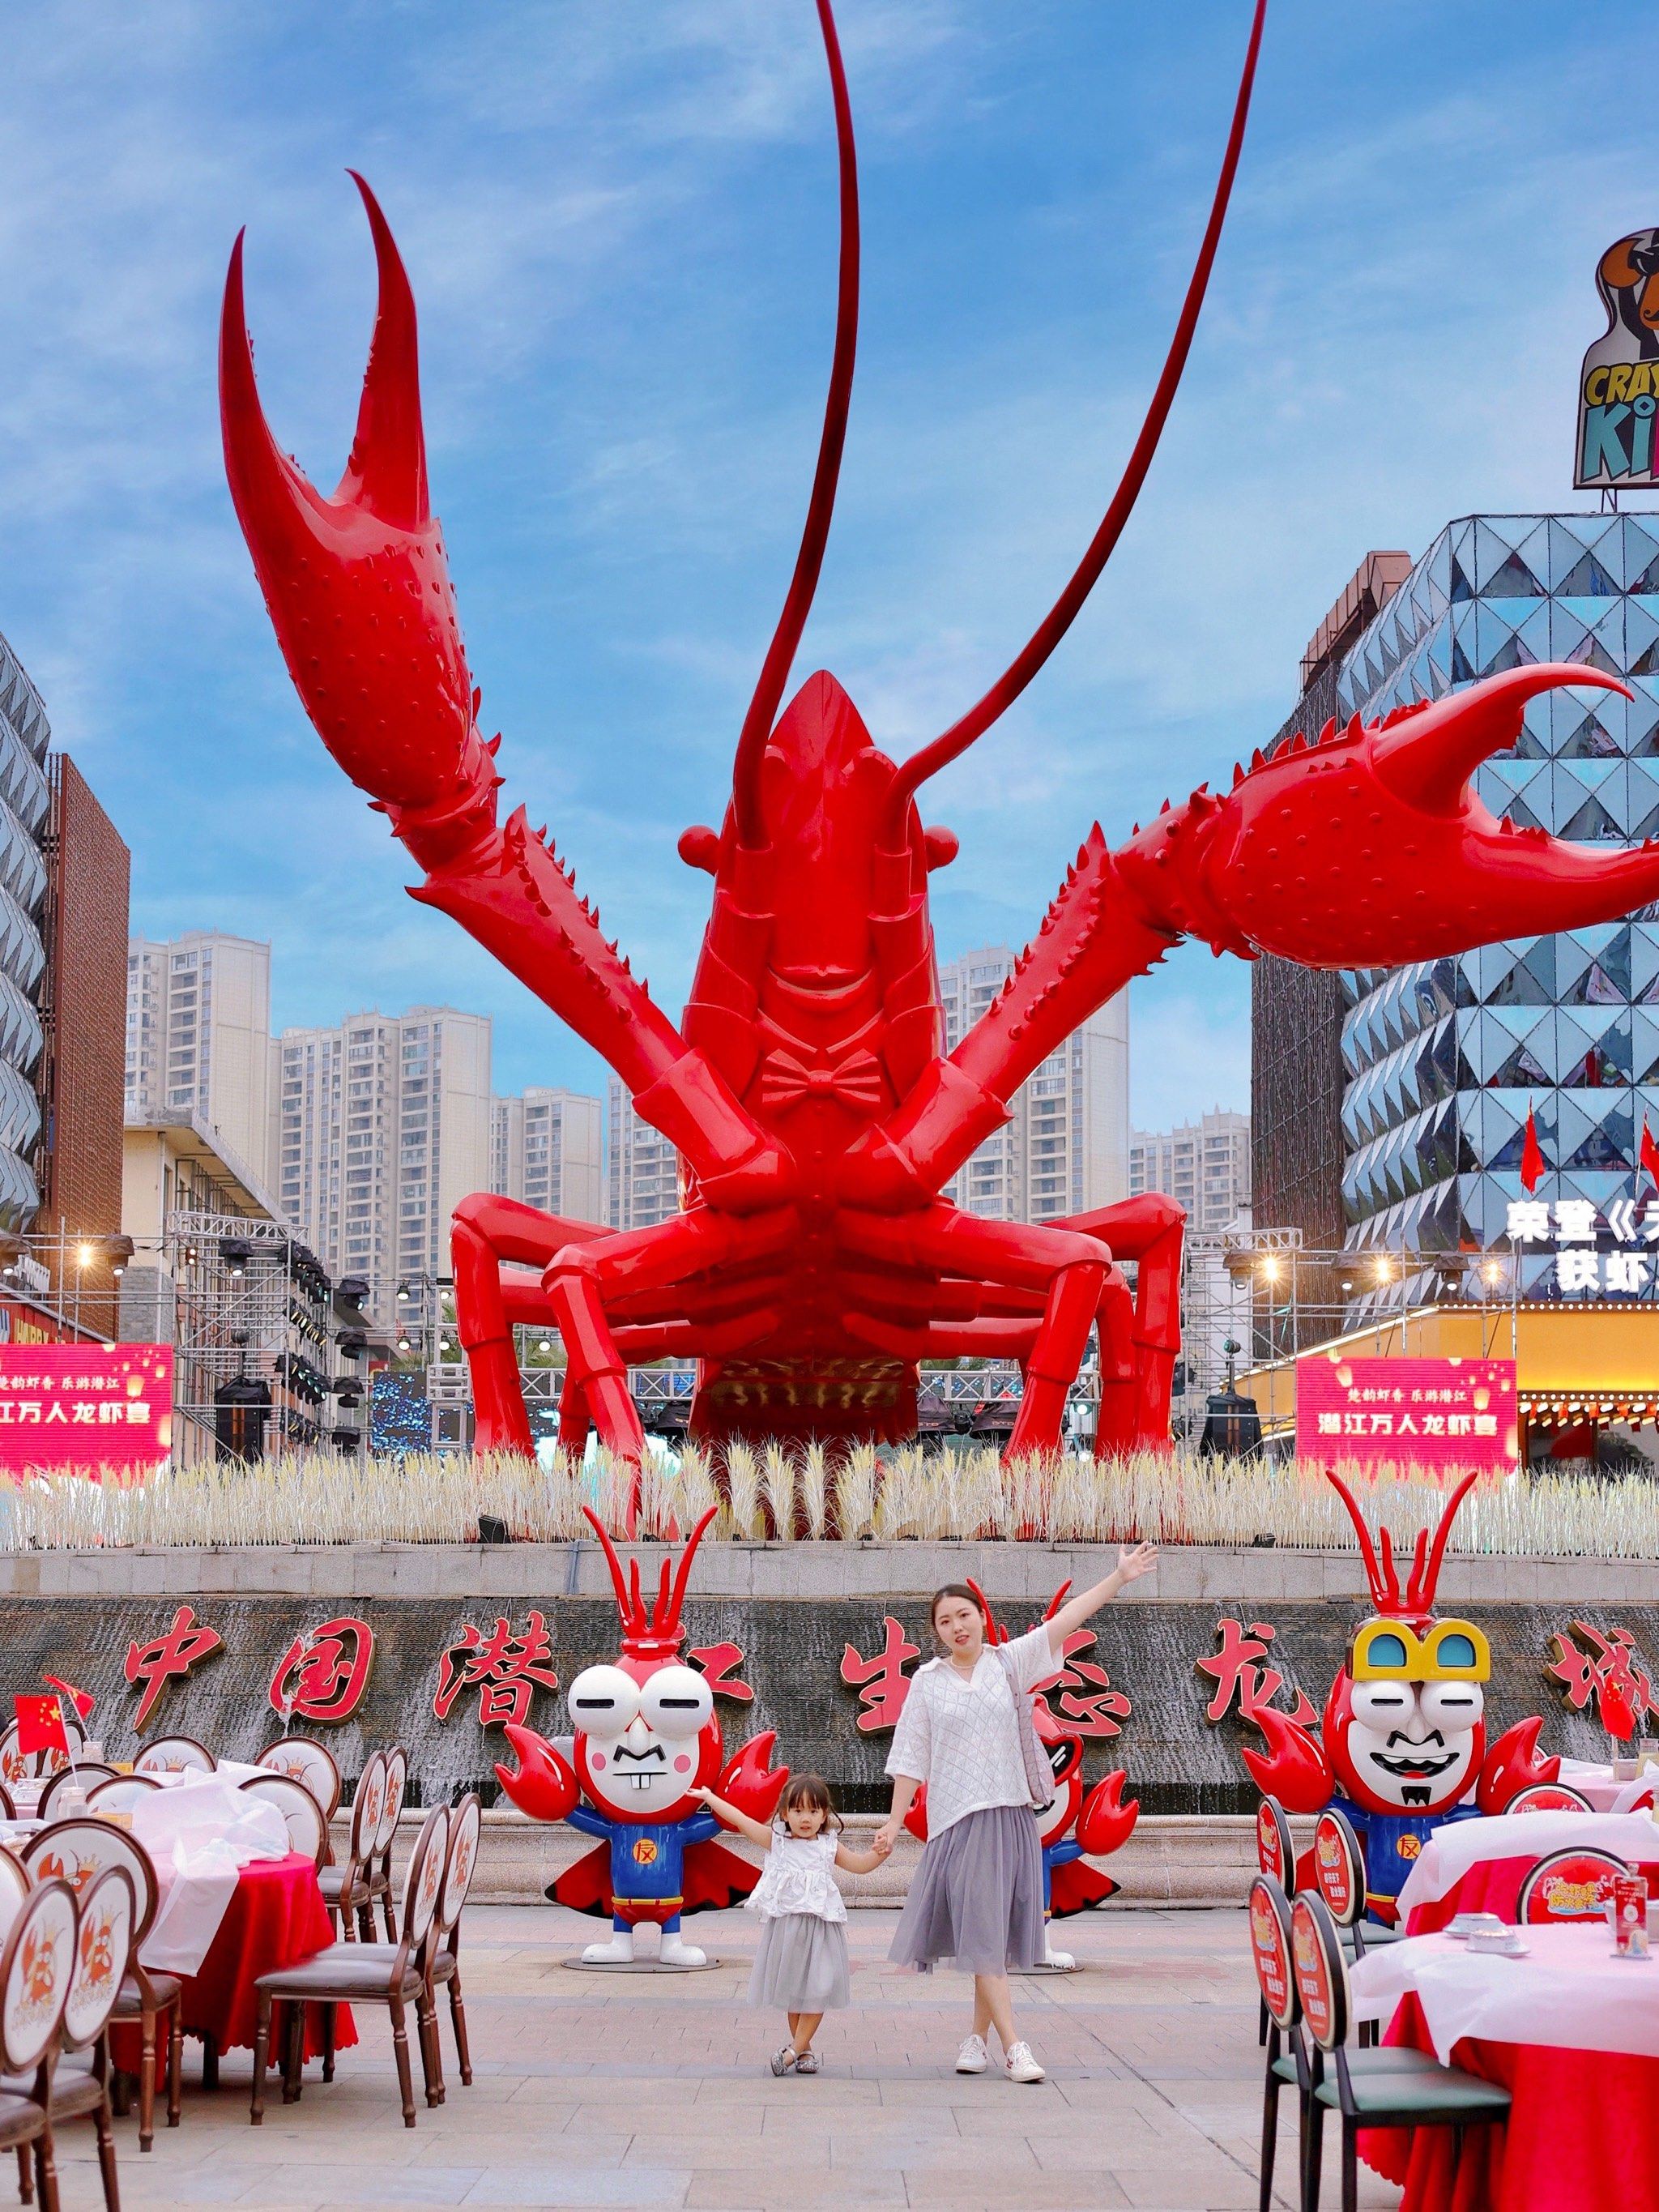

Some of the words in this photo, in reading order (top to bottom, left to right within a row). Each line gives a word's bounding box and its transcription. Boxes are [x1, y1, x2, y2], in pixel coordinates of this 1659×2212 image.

[1582, 395, 1659, 480] Ki
[1556, 1249, 1659, 1293] 获虾
[1318, 1412, 1497, 1436] 潜江万人龙虾宴
